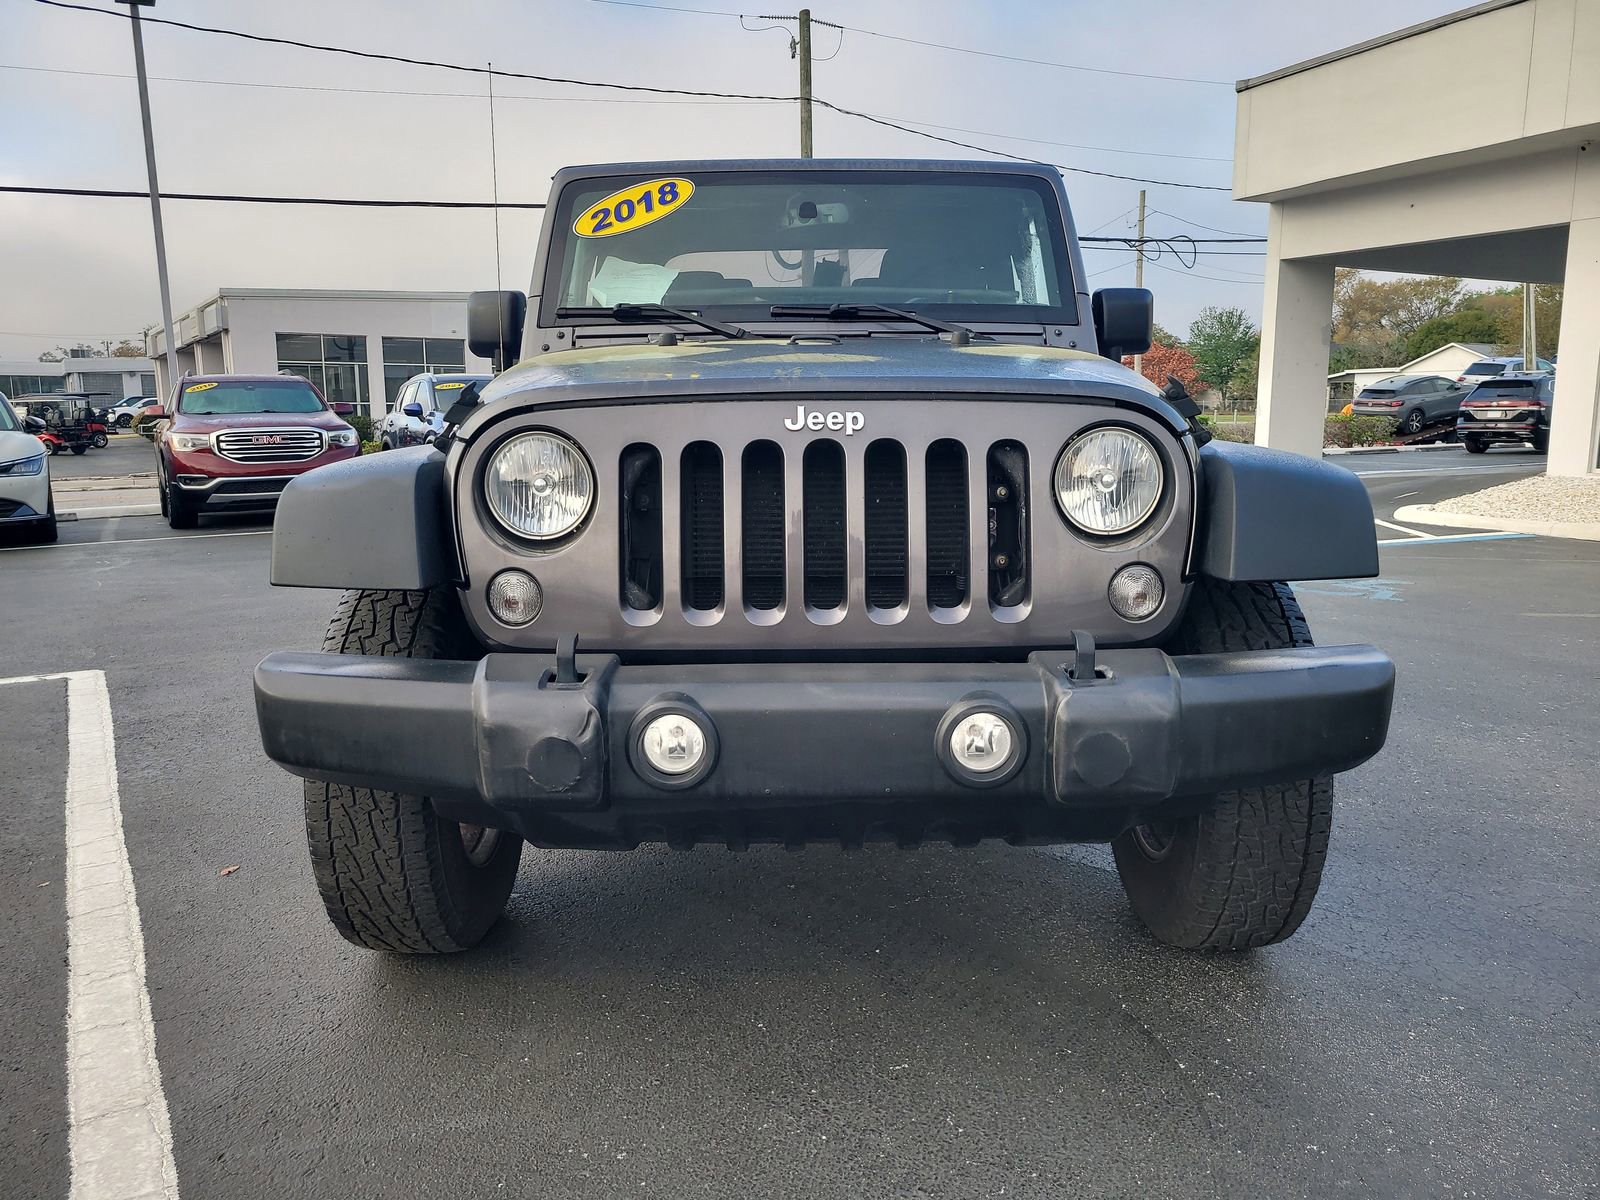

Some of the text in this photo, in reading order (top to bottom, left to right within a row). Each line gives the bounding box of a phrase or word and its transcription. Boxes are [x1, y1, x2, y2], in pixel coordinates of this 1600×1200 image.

[590, 182, 679, 233] 2018
[784, 405, 865, 436] Jeep
[252, 435, 290, 445] GMC
